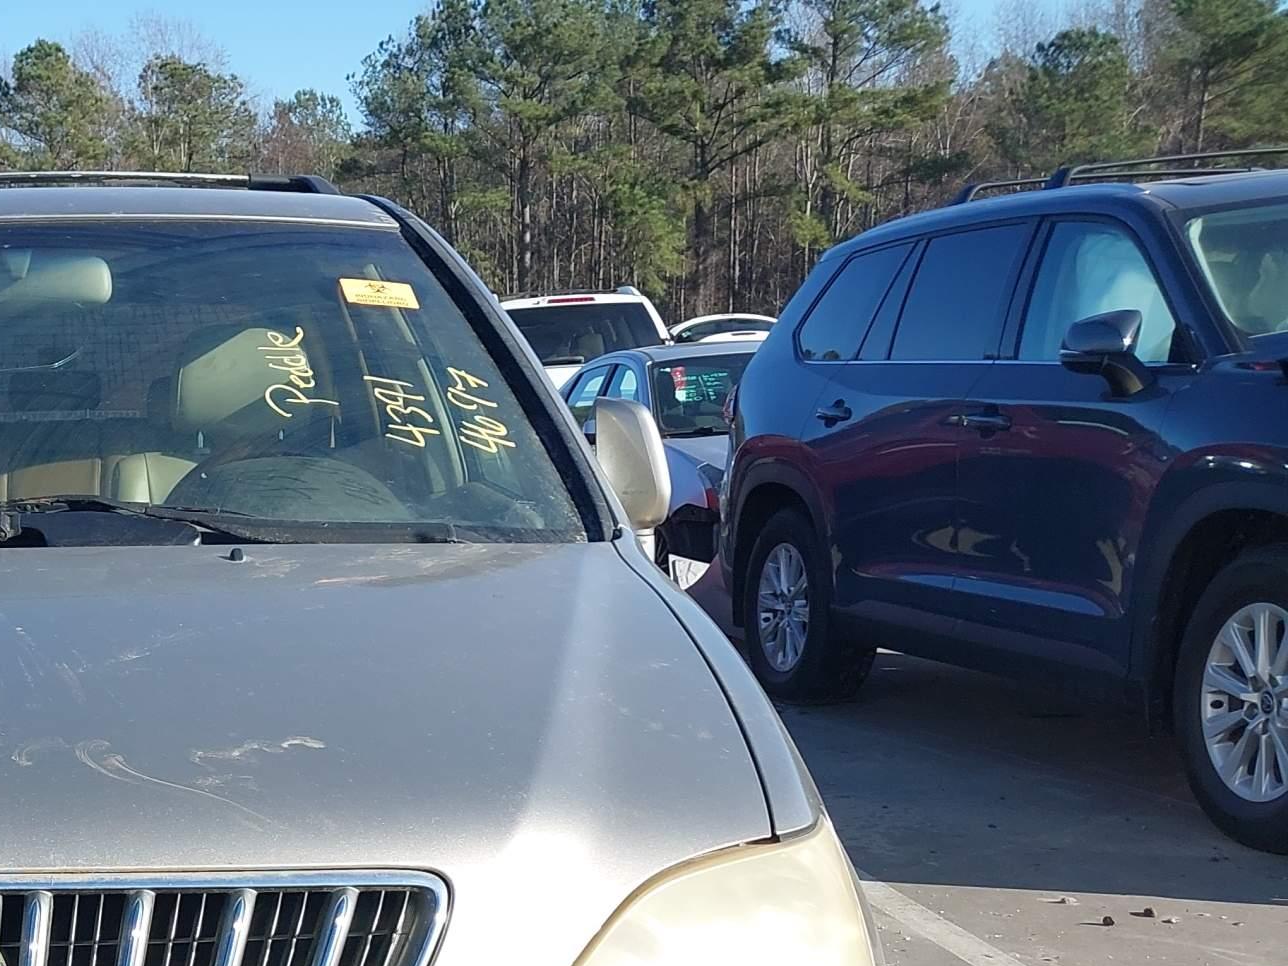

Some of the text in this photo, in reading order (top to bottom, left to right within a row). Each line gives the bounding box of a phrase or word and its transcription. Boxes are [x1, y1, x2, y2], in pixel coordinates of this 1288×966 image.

[257, 326, 340, 418] Peddle
[362, 374, 441, 448] 4391
[446, 366, 517, 454] 4697
